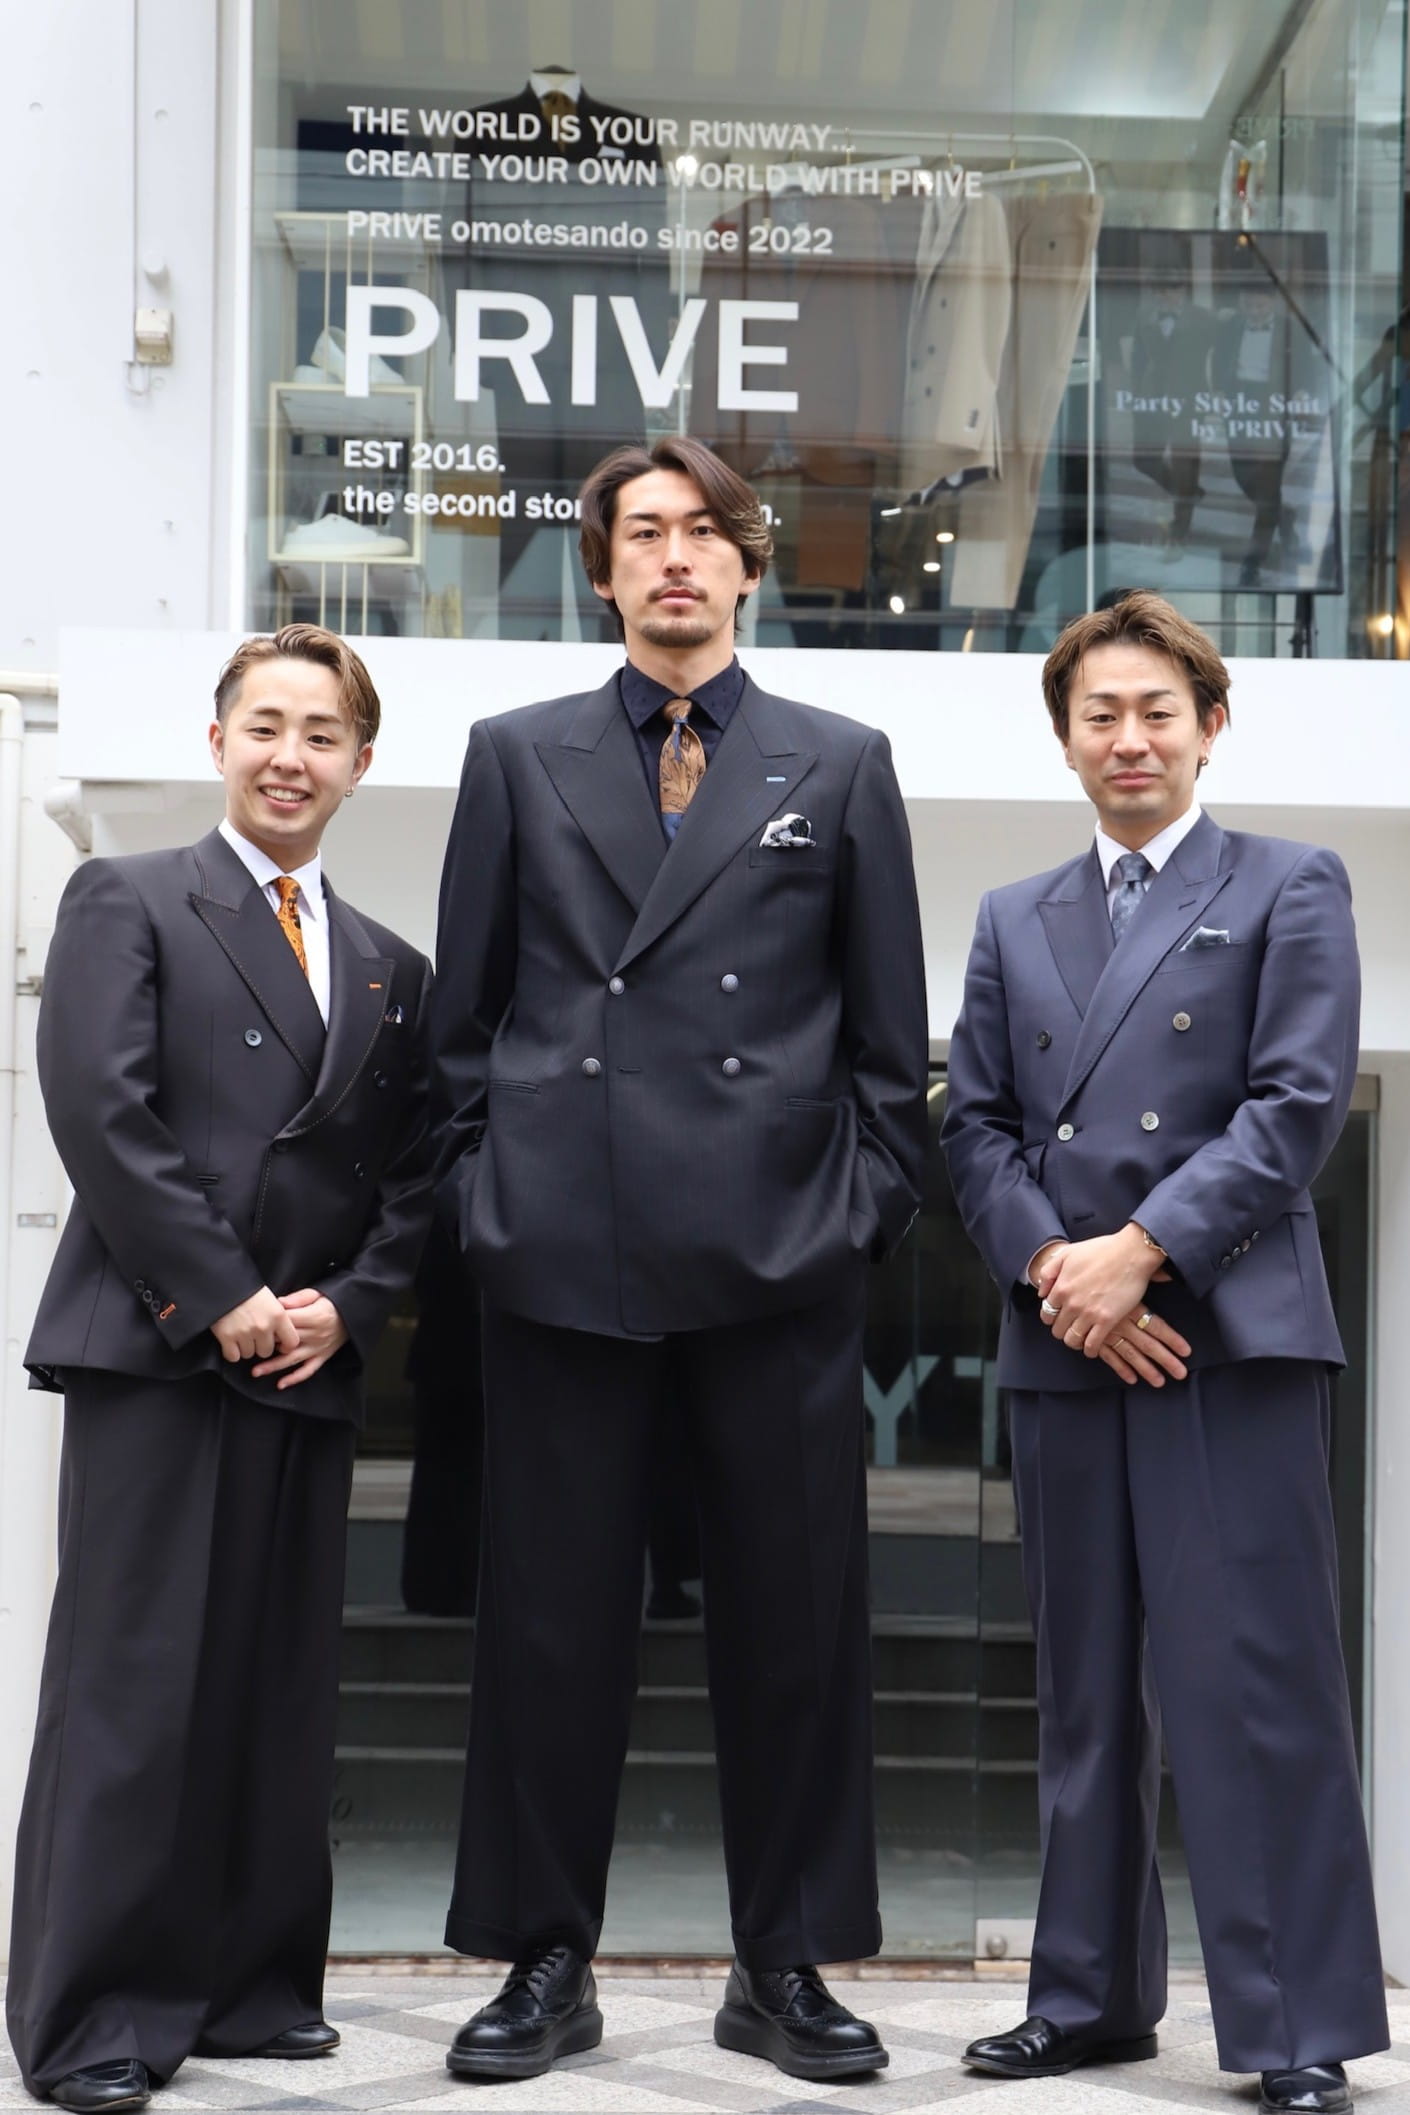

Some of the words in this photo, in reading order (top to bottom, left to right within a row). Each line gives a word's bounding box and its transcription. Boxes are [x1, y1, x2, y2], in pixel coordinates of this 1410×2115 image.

[347, 106, 409, 136] THE
[418, 109, 541, 142] WORLD
[551, 113, 581, 144] IS
[589, 115, 678, 147] YOUR
[689, 119, 856, 153] RUNWAY...
[345, 148, 471, 181] CREATE
[479, 153, 568, 185] YOUR
[578, 157, 657, 187] OWN
[667, 159, 787, 192] WORLD
[798, 165, 878, 195] WITH
[890, 168, 984, 199] PRIVE
[347, 210, 442, 241] PRIVE
[451, 217, 649, 249] omotesando
[657, 223, 740, 252] since
[748, 225, 833, 255] 2022
[344, 284, 800, 414] PRIVE
[1116, 389, 1183, 418] Party
[1194, 391, 1261, 418] Style
[1268, 392, 1320, 415] Suit
[1191, 419, 1215, 442] by
[1228, 419, 1311, 440] PRIVE
[343, 440, 403, 469] EST
[411, 442, 506, 473] 2016.
[343, 485, 395, 514] the
[403, 489, 516, 518] second
